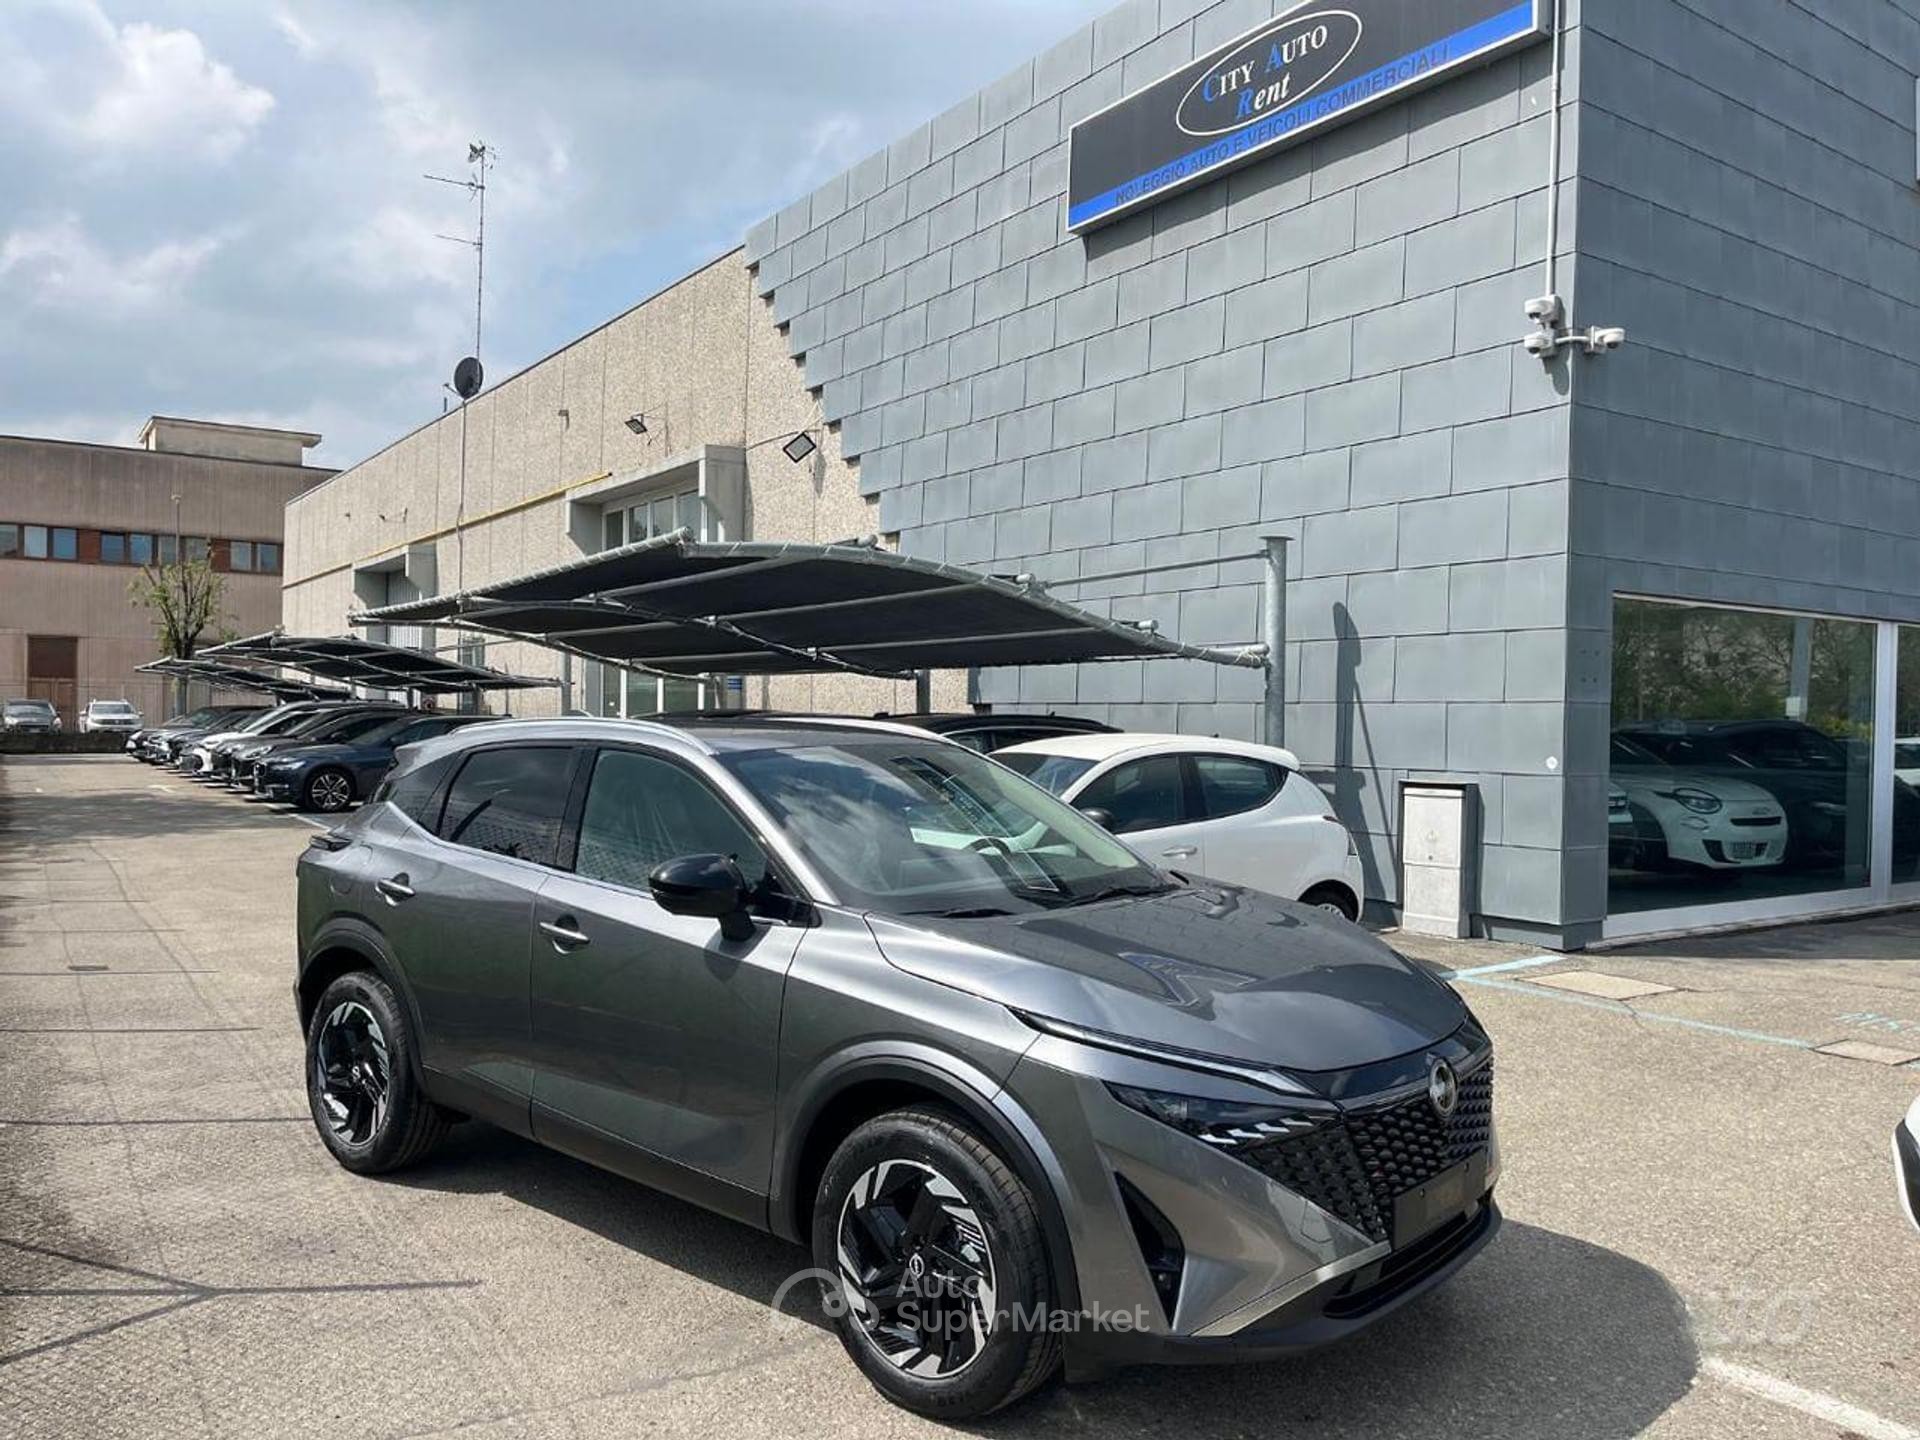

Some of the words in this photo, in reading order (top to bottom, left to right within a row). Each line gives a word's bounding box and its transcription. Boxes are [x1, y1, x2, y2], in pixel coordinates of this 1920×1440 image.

[1203, 60, 1255, 103] CITY
[1266, 25, 1328, 73] AUTO
[1235, 72, 1290, 121] Rent
[1115, 162, 1185, 204] NOLEGGIO
[1189, 143, 1229, 172] AUTO
[1234, 137, 1245, 152] E
[1247, 104, 1312, 144] VEICOLI
[1316, 44, 1449, 115] COMMERCIALI
